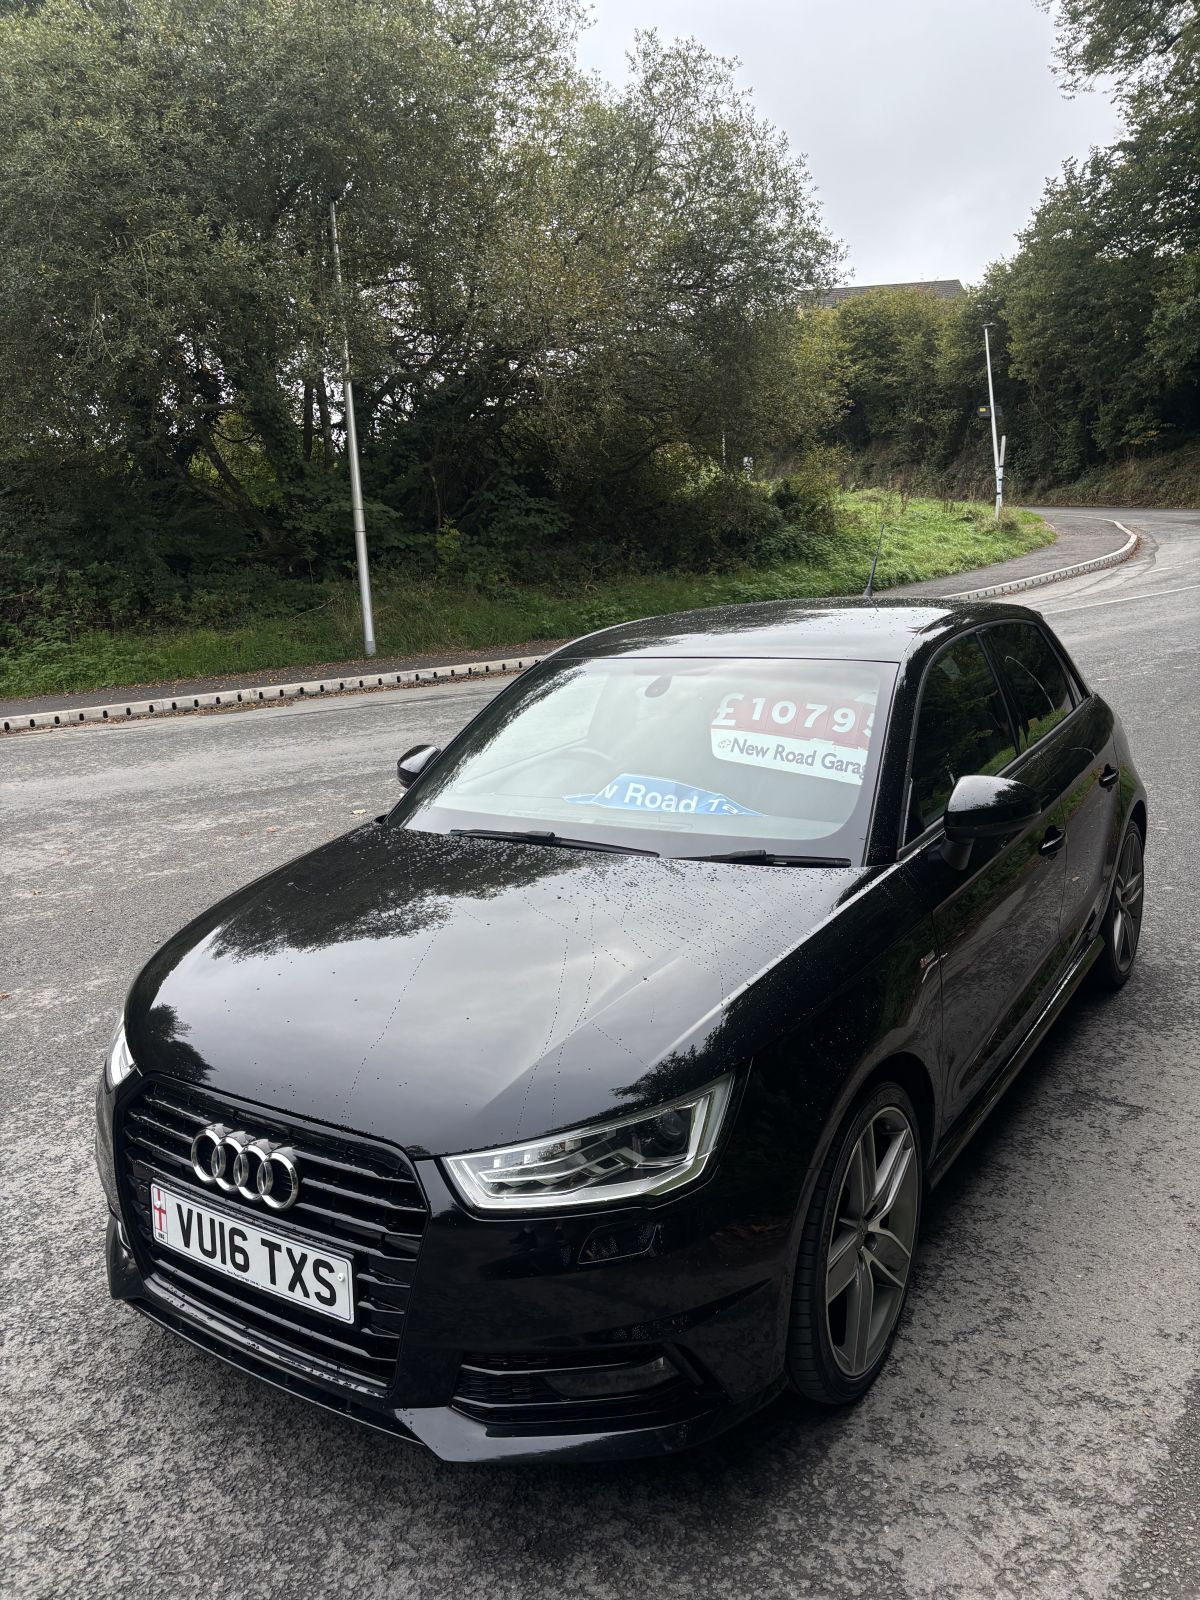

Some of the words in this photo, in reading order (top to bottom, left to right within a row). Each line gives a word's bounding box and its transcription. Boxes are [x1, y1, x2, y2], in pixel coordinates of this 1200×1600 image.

[730, 737, 770, 759] New
[773, 743, 817, 767] Road
[623, 782, 698, 813] Road
[176, 1202, 250, 1273] VU16
[260, 1237, 338, 1307] TXS
